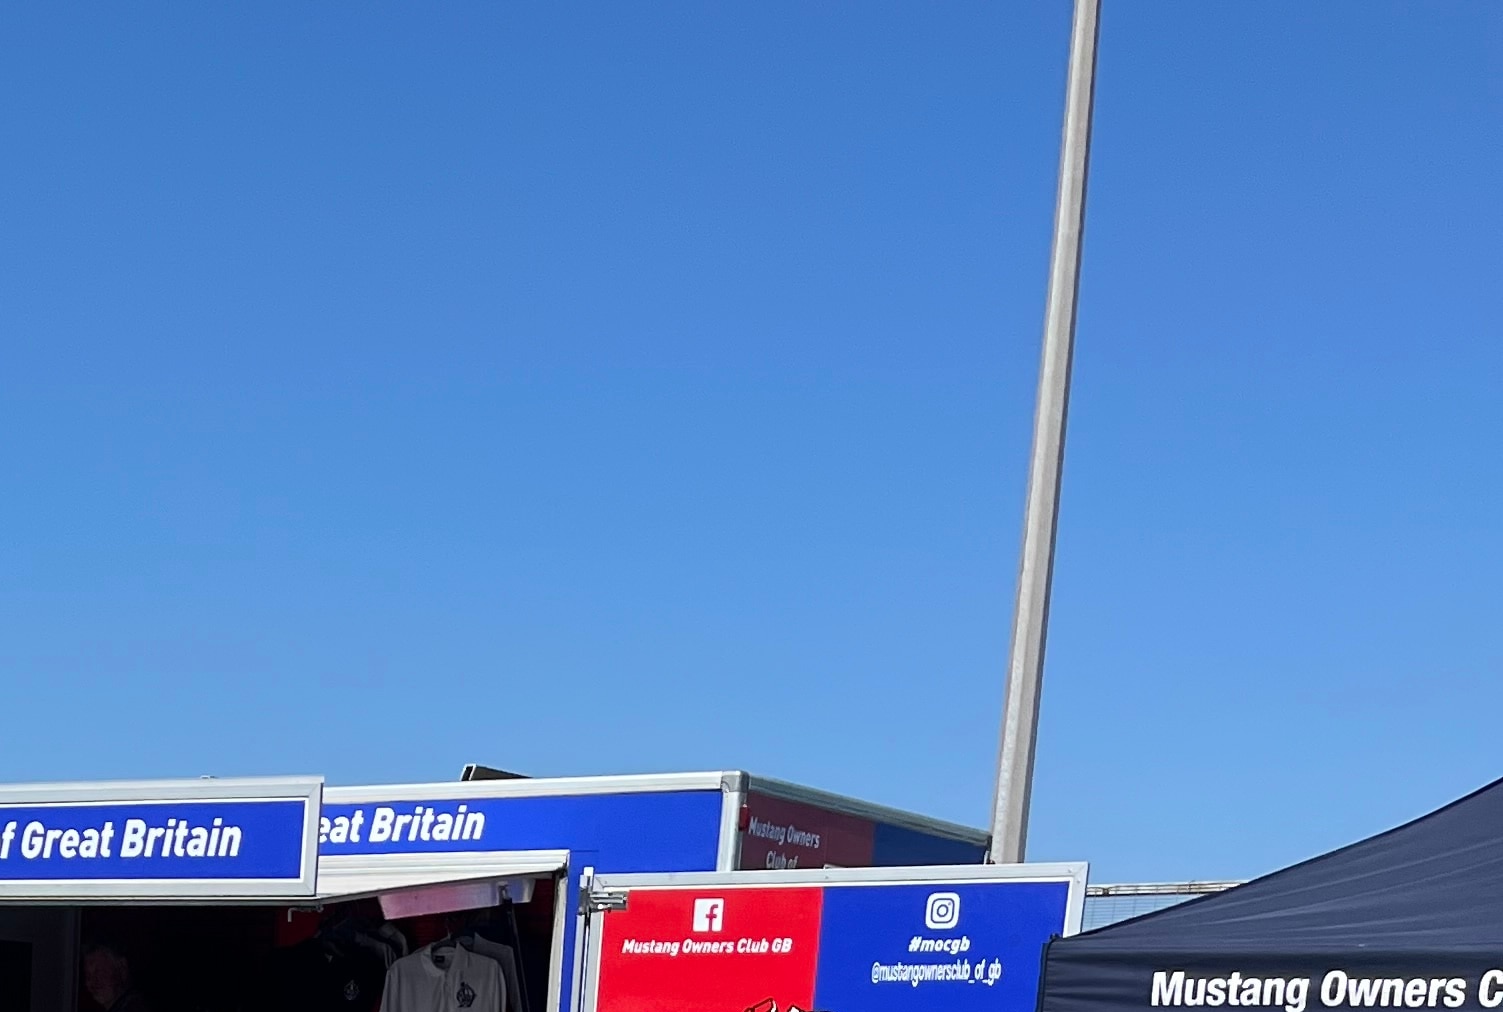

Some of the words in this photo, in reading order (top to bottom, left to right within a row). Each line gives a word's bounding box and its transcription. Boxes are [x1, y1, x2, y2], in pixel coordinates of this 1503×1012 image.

[21, 821, 115, 860] Great
[120, 817, 242, 858] Britain
[369, 805, 486, 843] Britain
[748, 816, 786, 846] Mustang
[787, 825, 820, 849] Owners
[622, 939, 679, 956] Mustang
[682, 939, 735, 954] Owners
[737, 939, 768, 954] Club
[771, 938, 792, 954] GB
[908, 936, 970, 953] #mocgb
[1321, 970, 1466, 1007] Owners
